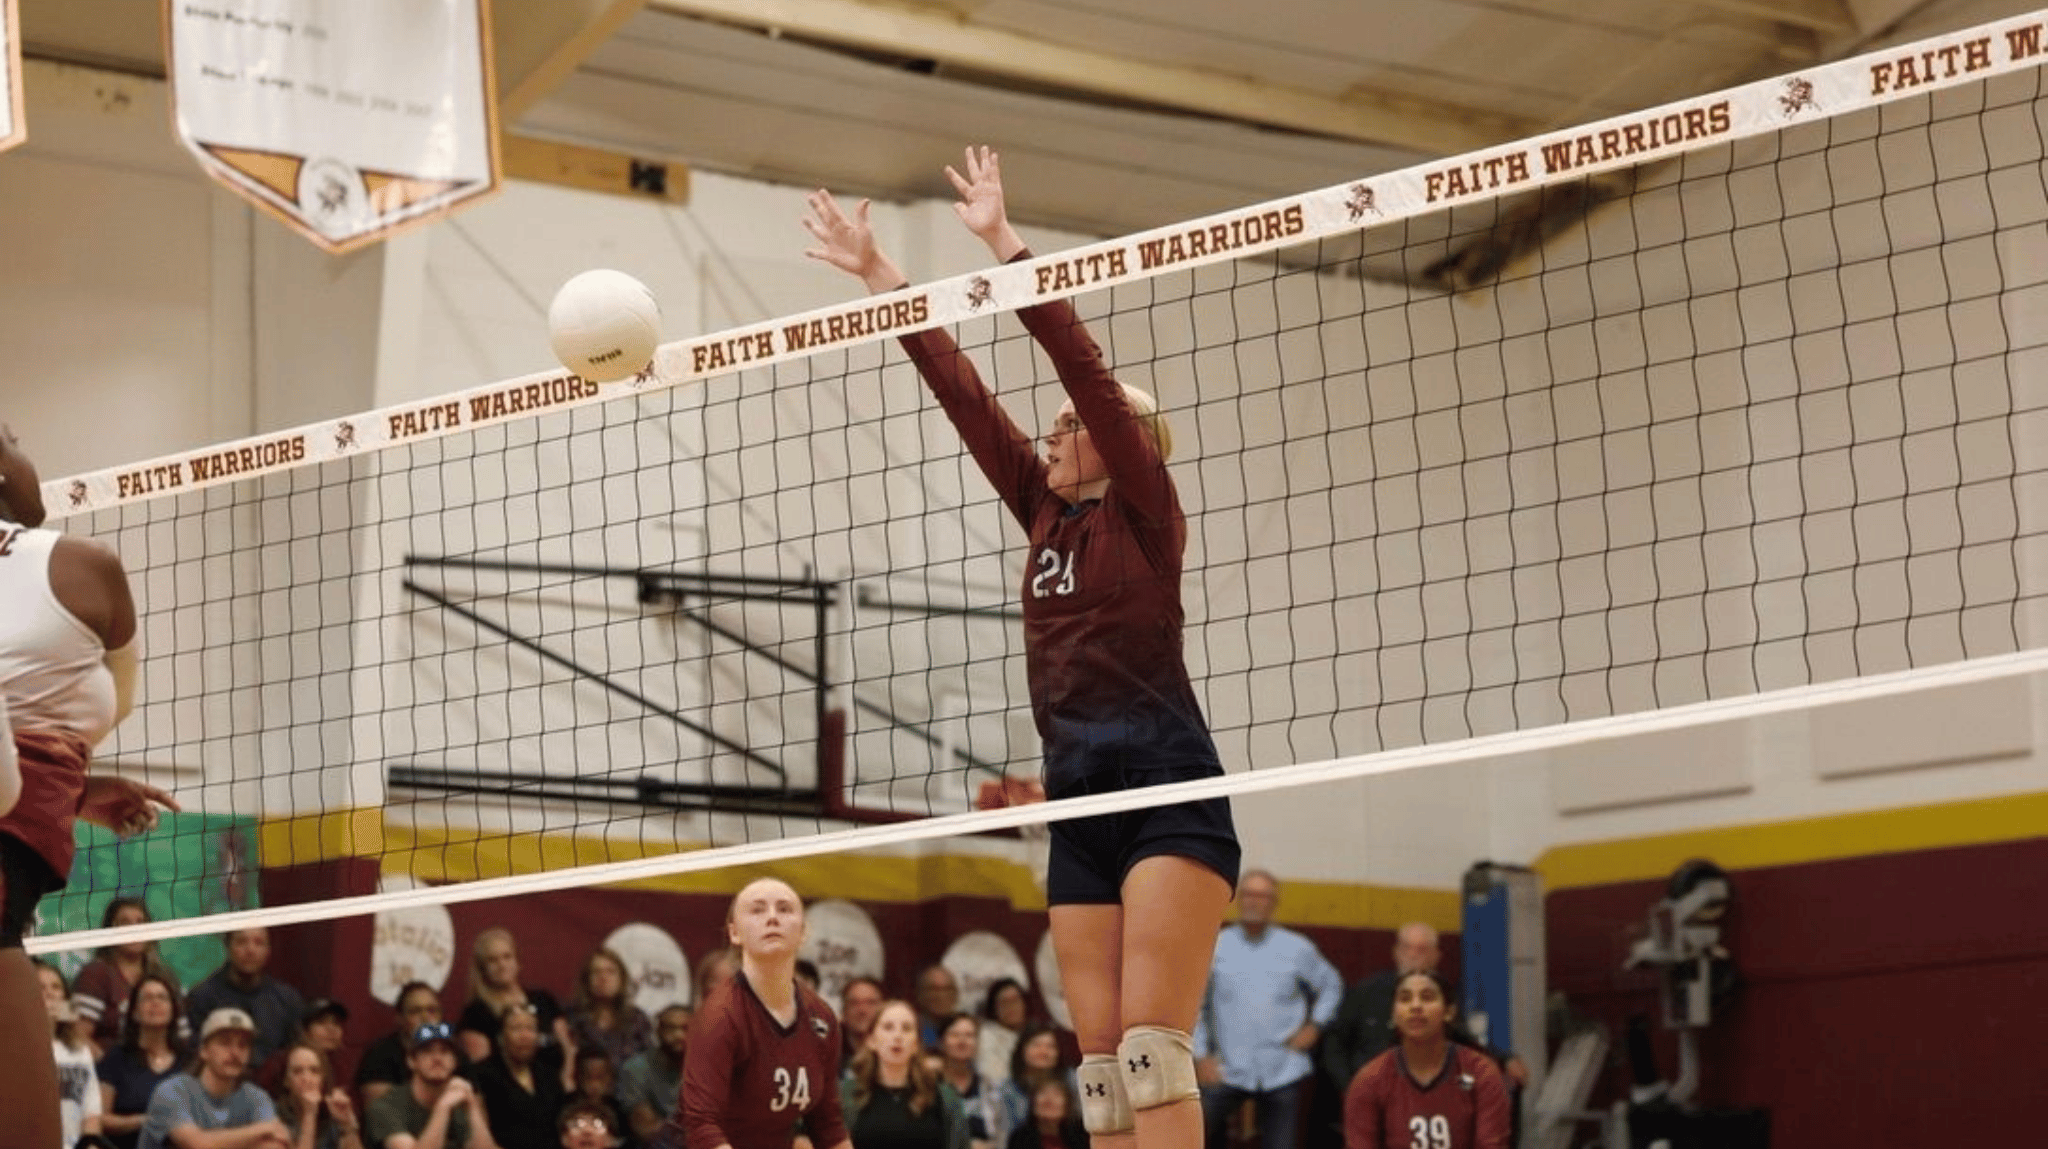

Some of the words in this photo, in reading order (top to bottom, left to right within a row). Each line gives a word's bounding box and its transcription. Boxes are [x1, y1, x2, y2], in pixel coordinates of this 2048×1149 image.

[1871, 36, 1992, 96] FAITH
[2005, 23, 2048, 61] W
[1424, 150, 1528, 203] FAITH
[1541, 100, 1732, 175] WARRIORS
[1035, 248, 1128, 295] FAITH
[1138, 204, 1304, 271] WARRIORS
[692, 330, 774, 373] FAITH
[782, 294, 929, 352] WARRIORS
[388, 402, 460, 439] FAITH
[469, 374, 599, 422] WARRIORS
[116, 463, 183, 498] FAITH
[189, 435, 305, 483] WARRIORS
[770, 1066, 811, 1112] 34
[1408, 1113, 1451, 1149] 39
